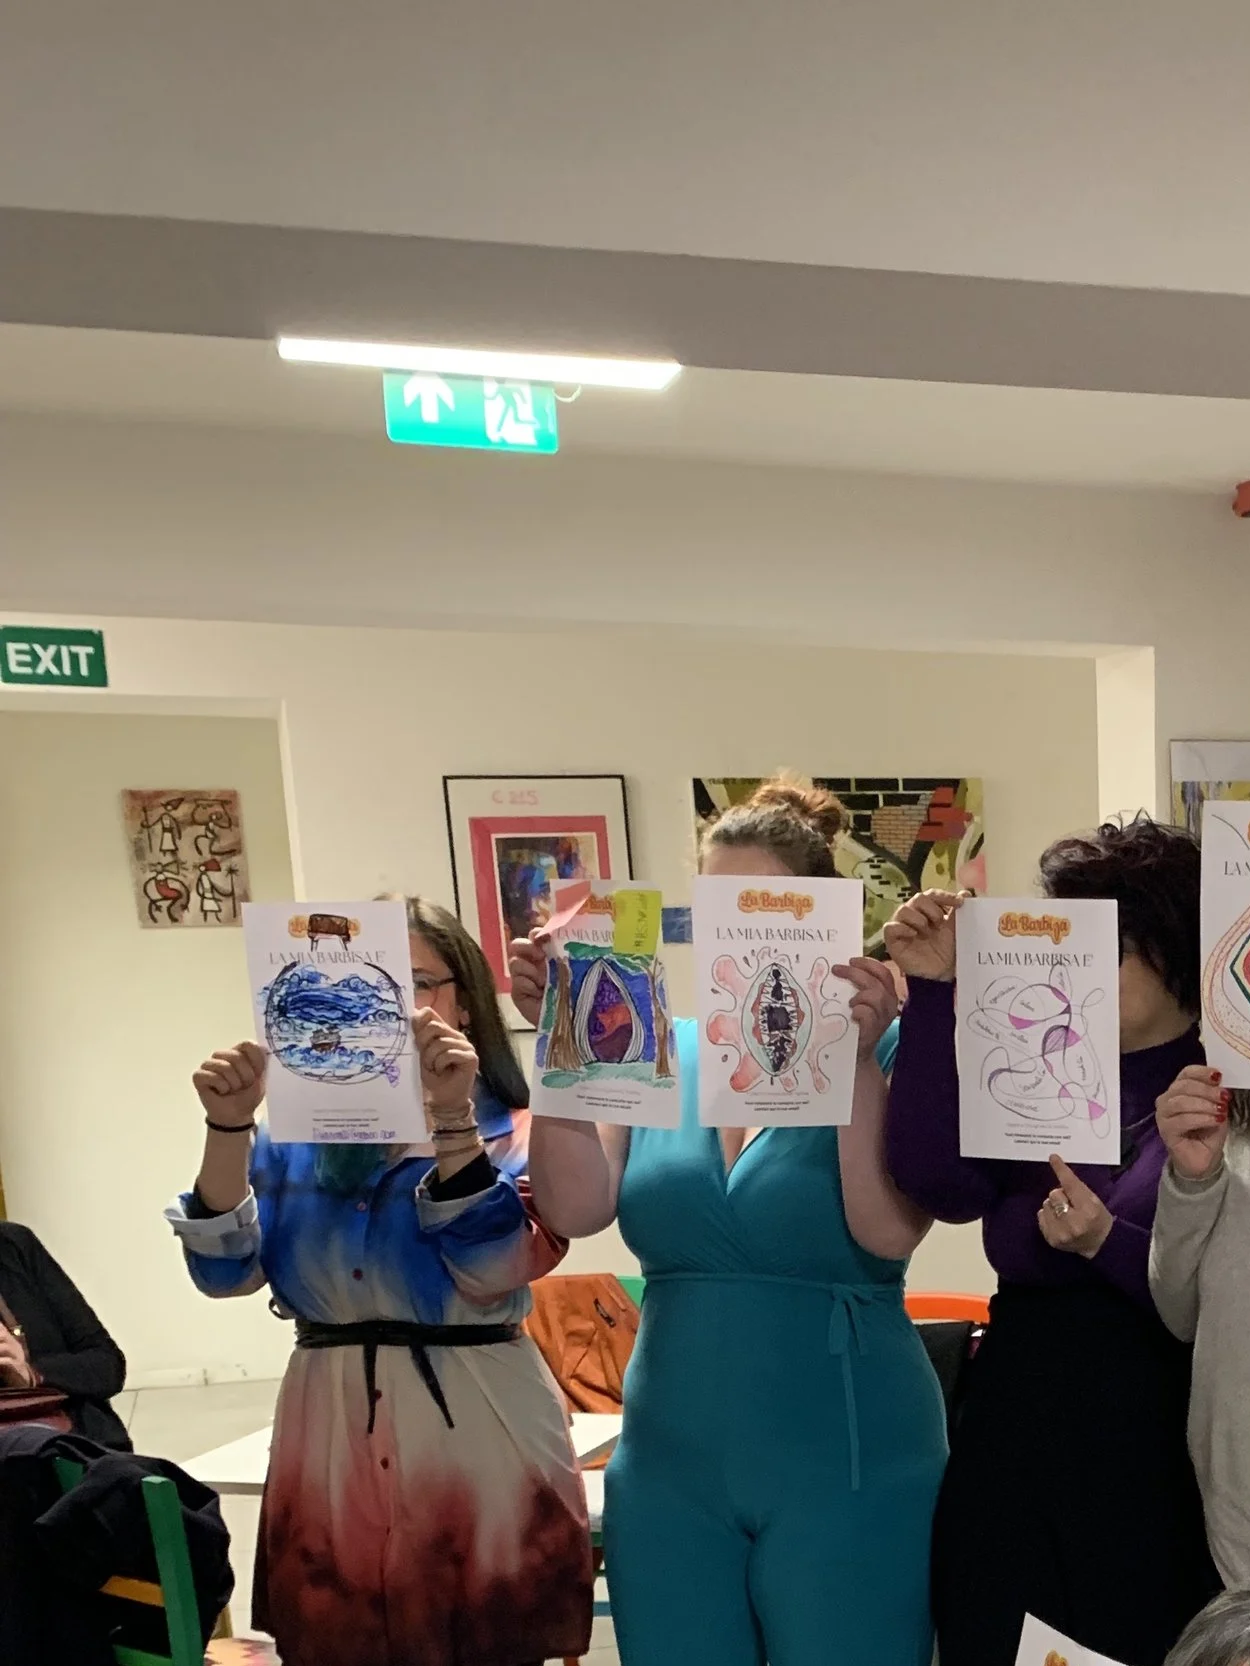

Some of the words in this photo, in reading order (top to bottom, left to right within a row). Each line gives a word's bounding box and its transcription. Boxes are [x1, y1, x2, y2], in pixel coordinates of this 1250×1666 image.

[6, 642, 95, 677] EXIT
[1224, 860, 1241, 876] LA
[740, 891, 758, 908] La
[1001, 914, 1017, 931] La
[716, 927, 734, 940] LA
[737, 928, 762, 940] MIA
[765, 928, 824, 941] BARBISA
[977, 951, 995, 965] LA
[996, 952, 1021, 966] MIA
[1024, 952, 1080, 967] BARBISA
